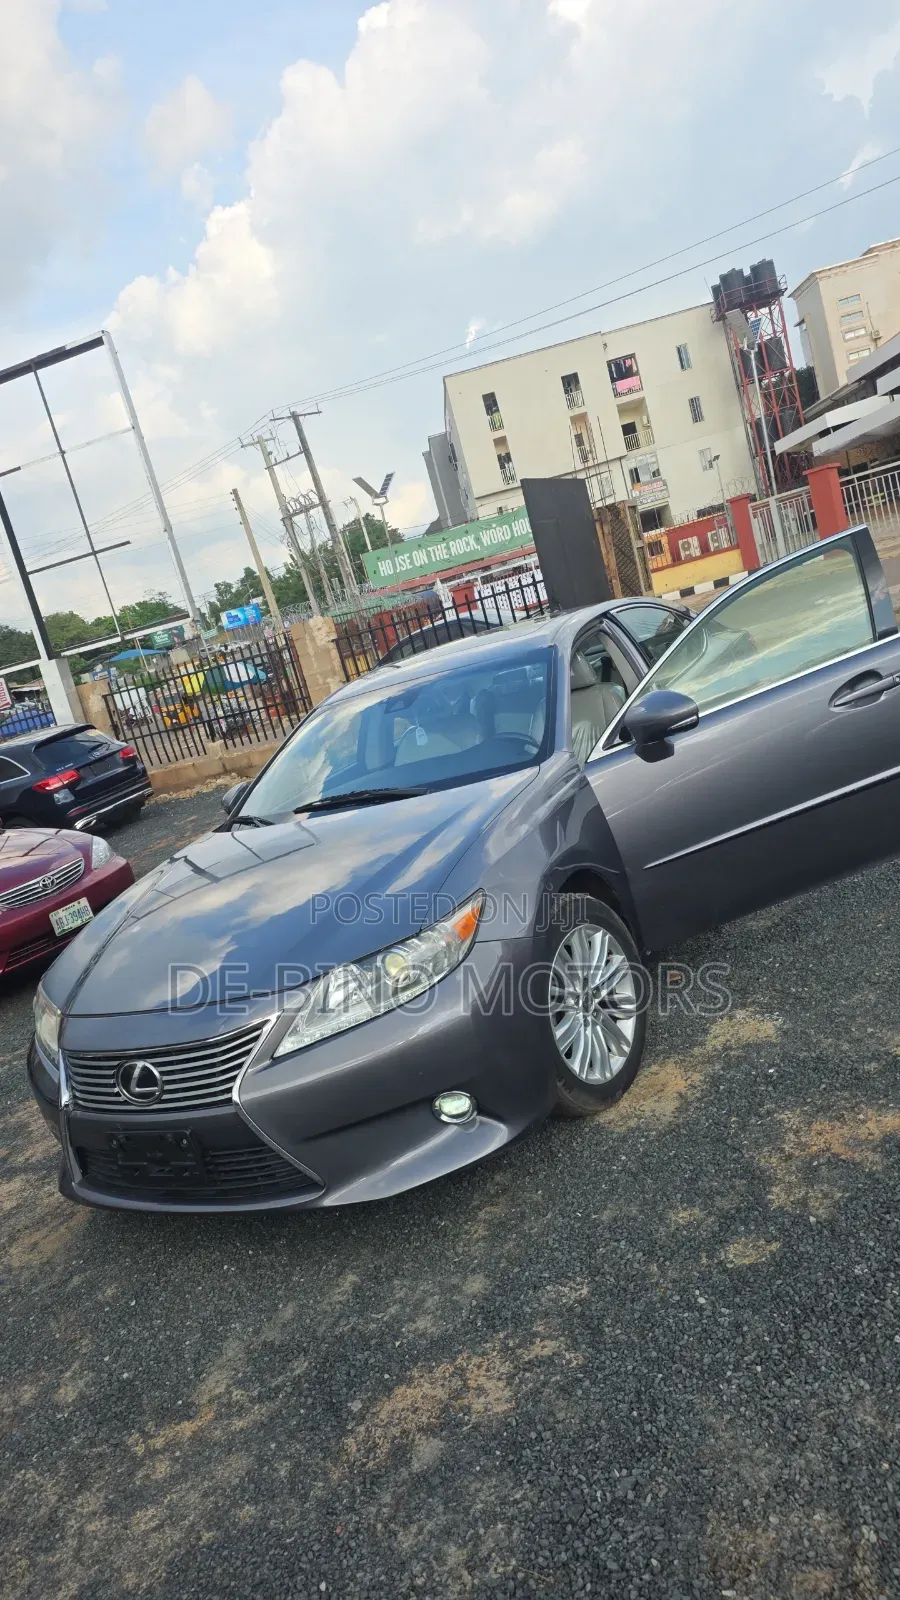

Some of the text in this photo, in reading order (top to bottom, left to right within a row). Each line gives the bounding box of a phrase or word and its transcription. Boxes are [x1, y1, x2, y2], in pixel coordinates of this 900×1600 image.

[412, 549, 427, 567] ON
[427, 542, 450, 563] THE
[450, 534, 481, 557] ROCK,
[480, 525, 511, 545] WORD
